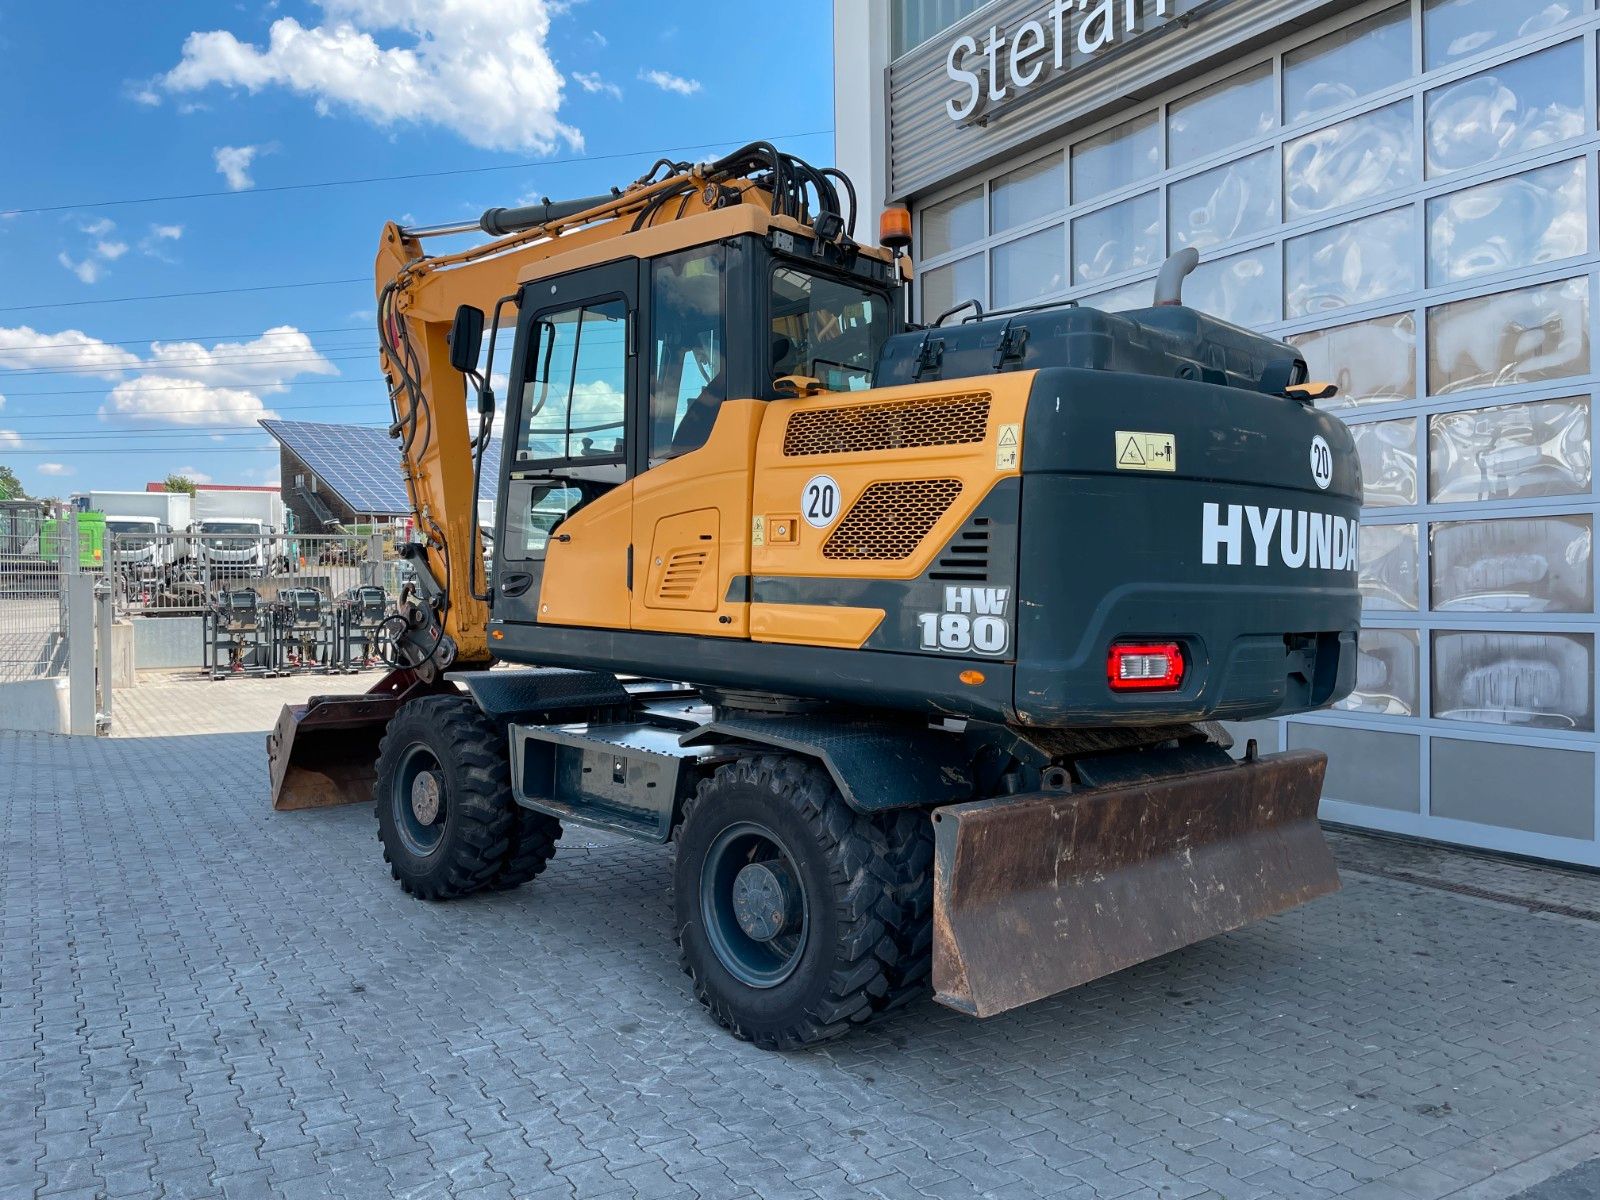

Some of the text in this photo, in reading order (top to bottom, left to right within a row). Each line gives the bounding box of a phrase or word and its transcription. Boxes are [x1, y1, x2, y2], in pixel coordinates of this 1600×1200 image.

[1314, 444, 1329, 479] 20
[808, 484, 834, 518] 20
[1201, 502, 1360, 572] HYUNDA
[945, 586, 1009, 615] HW
[918, 612, 1008, 654] 180
